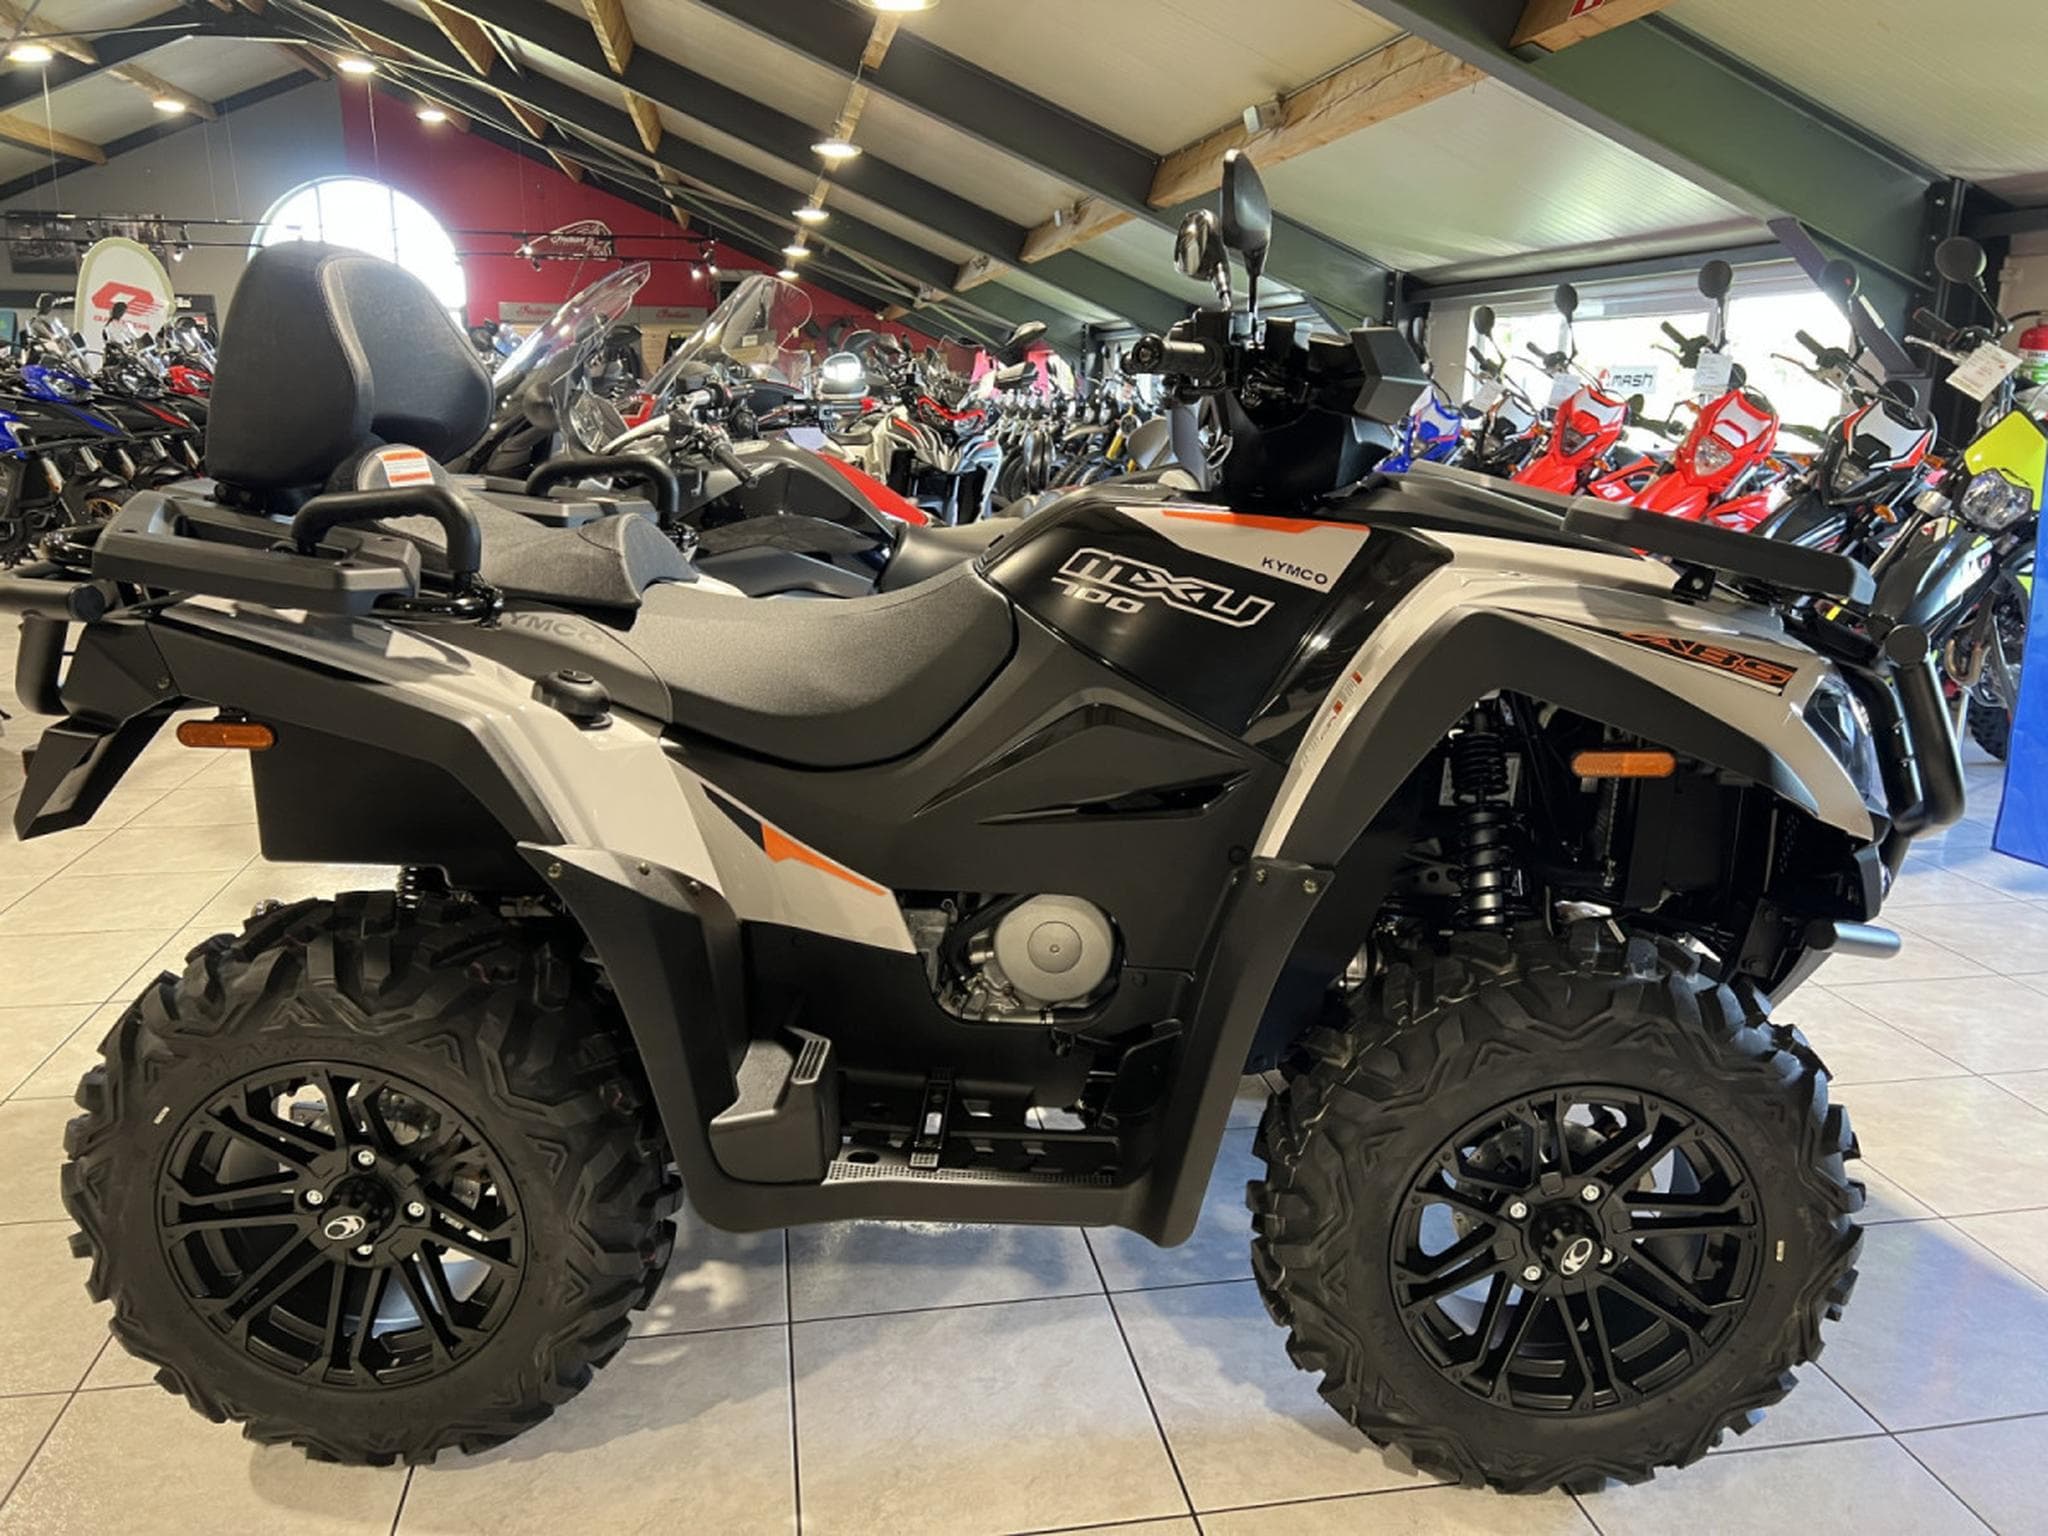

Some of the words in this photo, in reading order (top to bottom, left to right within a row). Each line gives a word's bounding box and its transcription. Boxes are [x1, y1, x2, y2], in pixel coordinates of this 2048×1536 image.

[1058, 548, 1275, 627] MXU
[1261, 556, 1329, 586] KYMCO
[1051, 577, 1145, 613] 700
[1624, 630, 1794, 684] ABS
